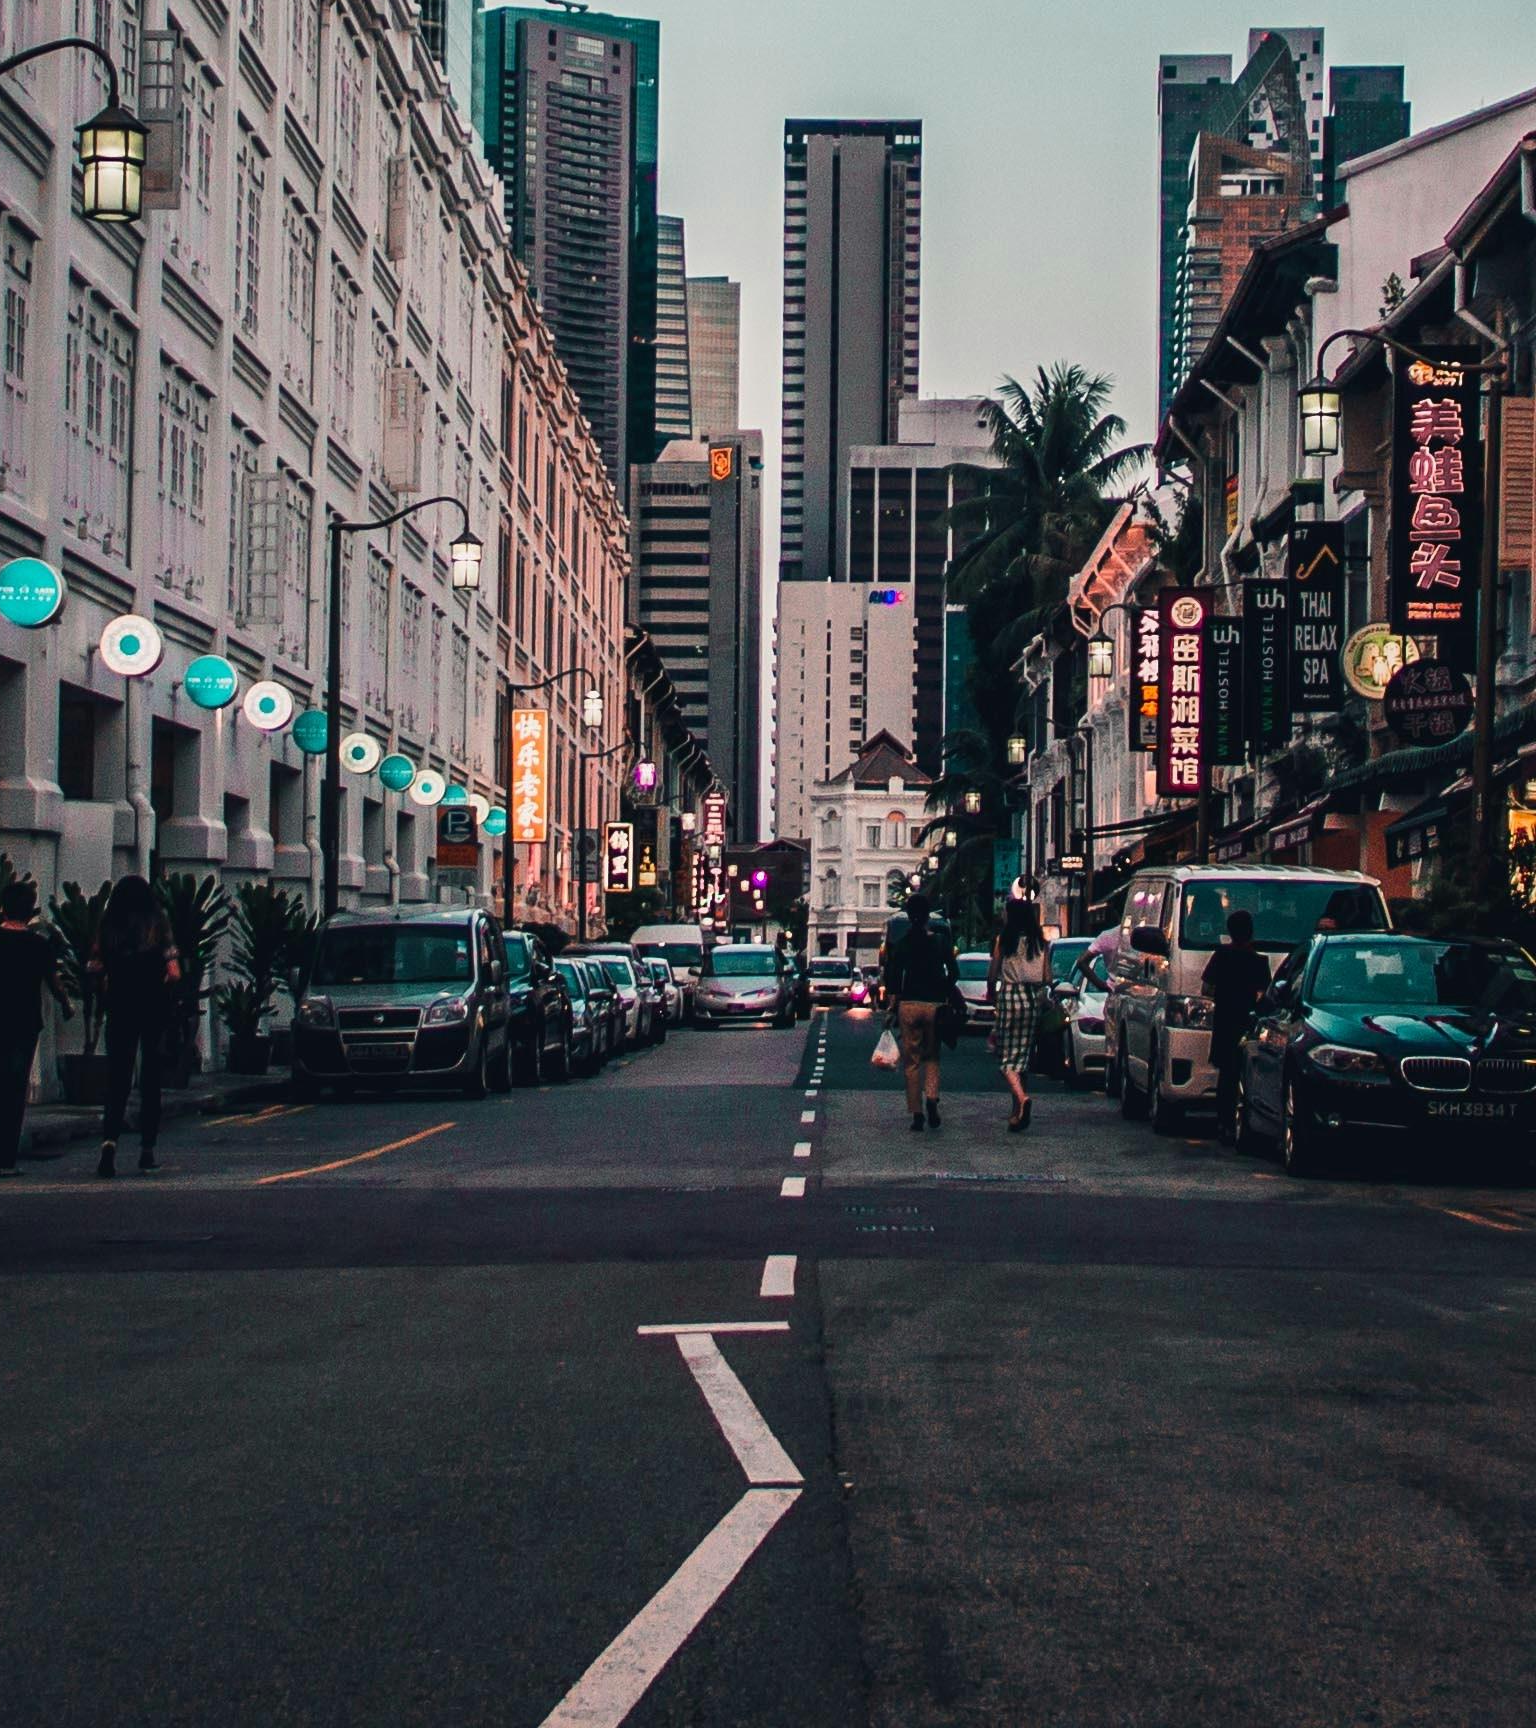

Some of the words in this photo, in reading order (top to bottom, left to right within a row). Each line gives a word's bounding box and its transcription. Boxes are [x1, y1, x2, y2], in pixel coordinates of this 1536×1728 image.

[1300, 591, 1331, 618] THAI
[1261, 613, 1275, 681] HOSTEL
[1294, 625, 1337, 651] RELAX
[1217, 649, 1229, 709] HOSTEL
[1304, 658, 1329, 684] SPA
